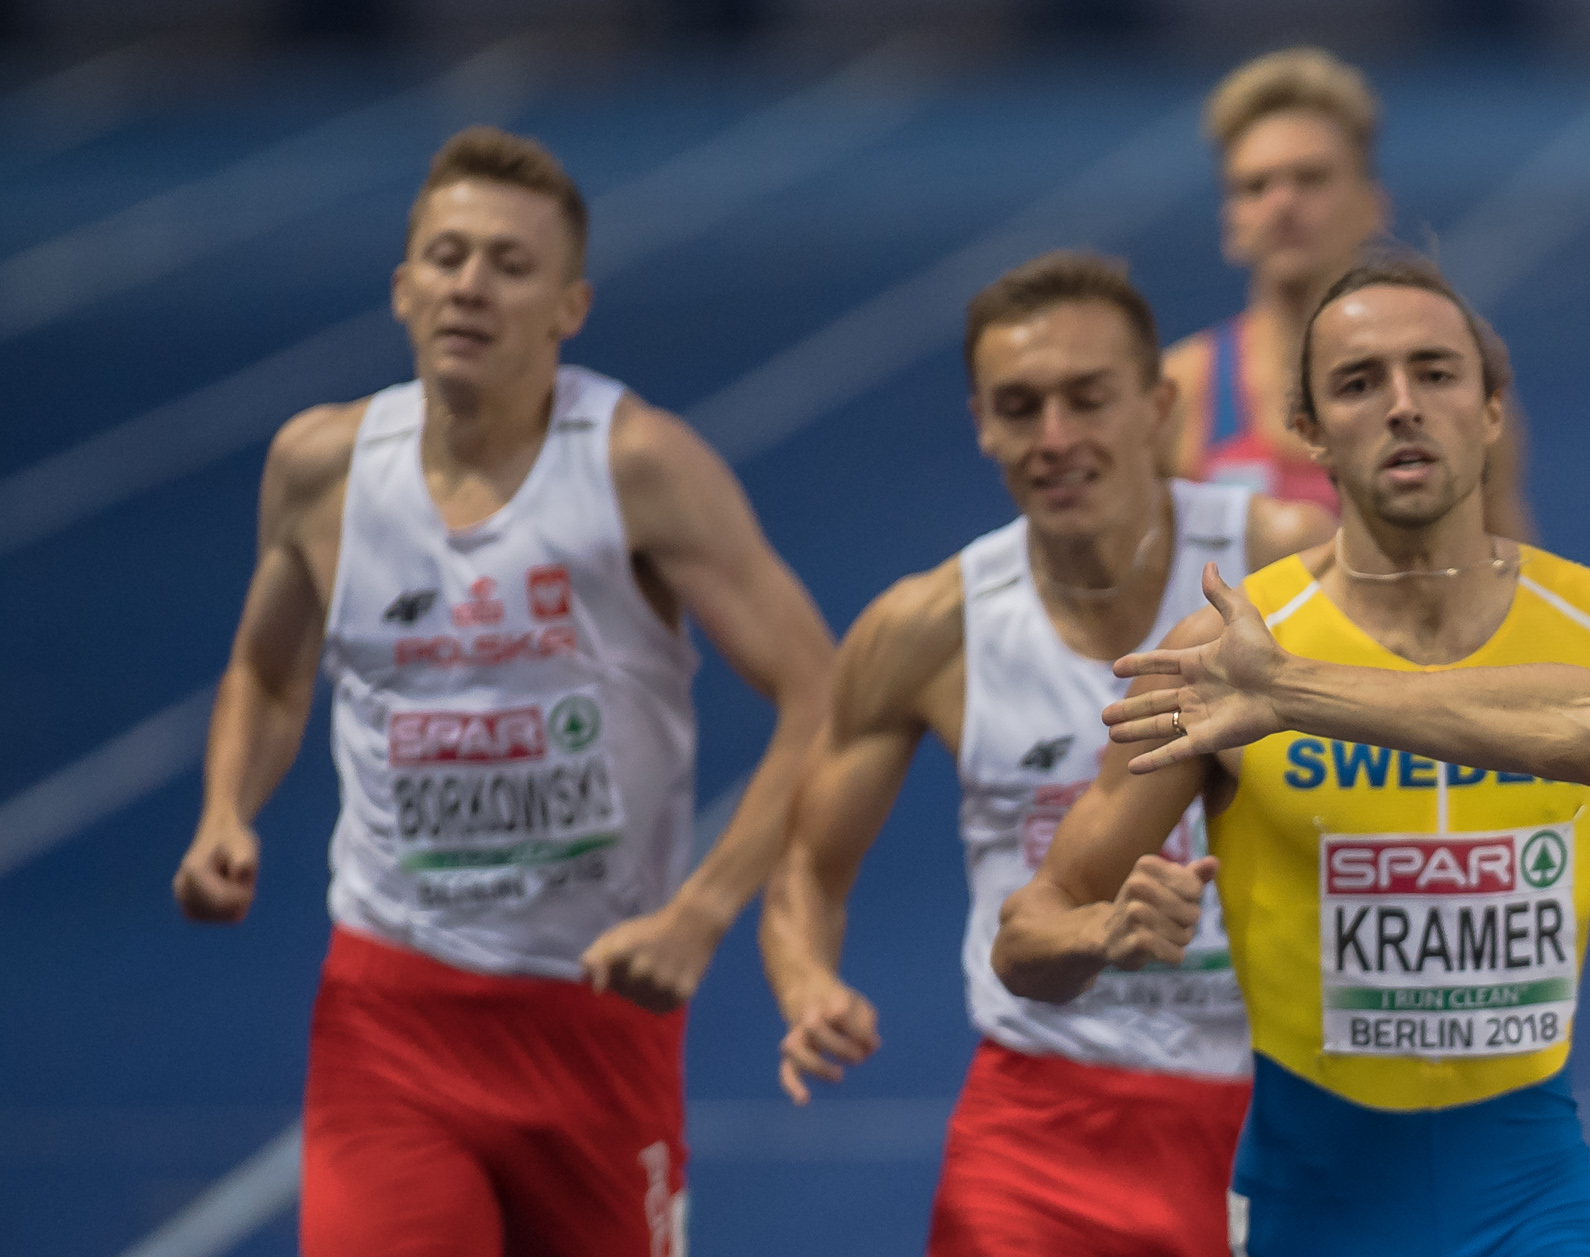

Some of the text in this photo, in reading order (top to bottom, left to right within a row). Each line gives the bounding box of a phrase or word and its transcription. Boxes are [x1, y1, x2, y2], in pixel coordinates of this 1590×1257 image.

[394, 712, 541, 757] SPAR
[1330, 845, 1511, 891] SPAR
[1335, 900, 1567, 974] KRAMER
[1350, 1011, 1559, 1048] BERLIN 2018
